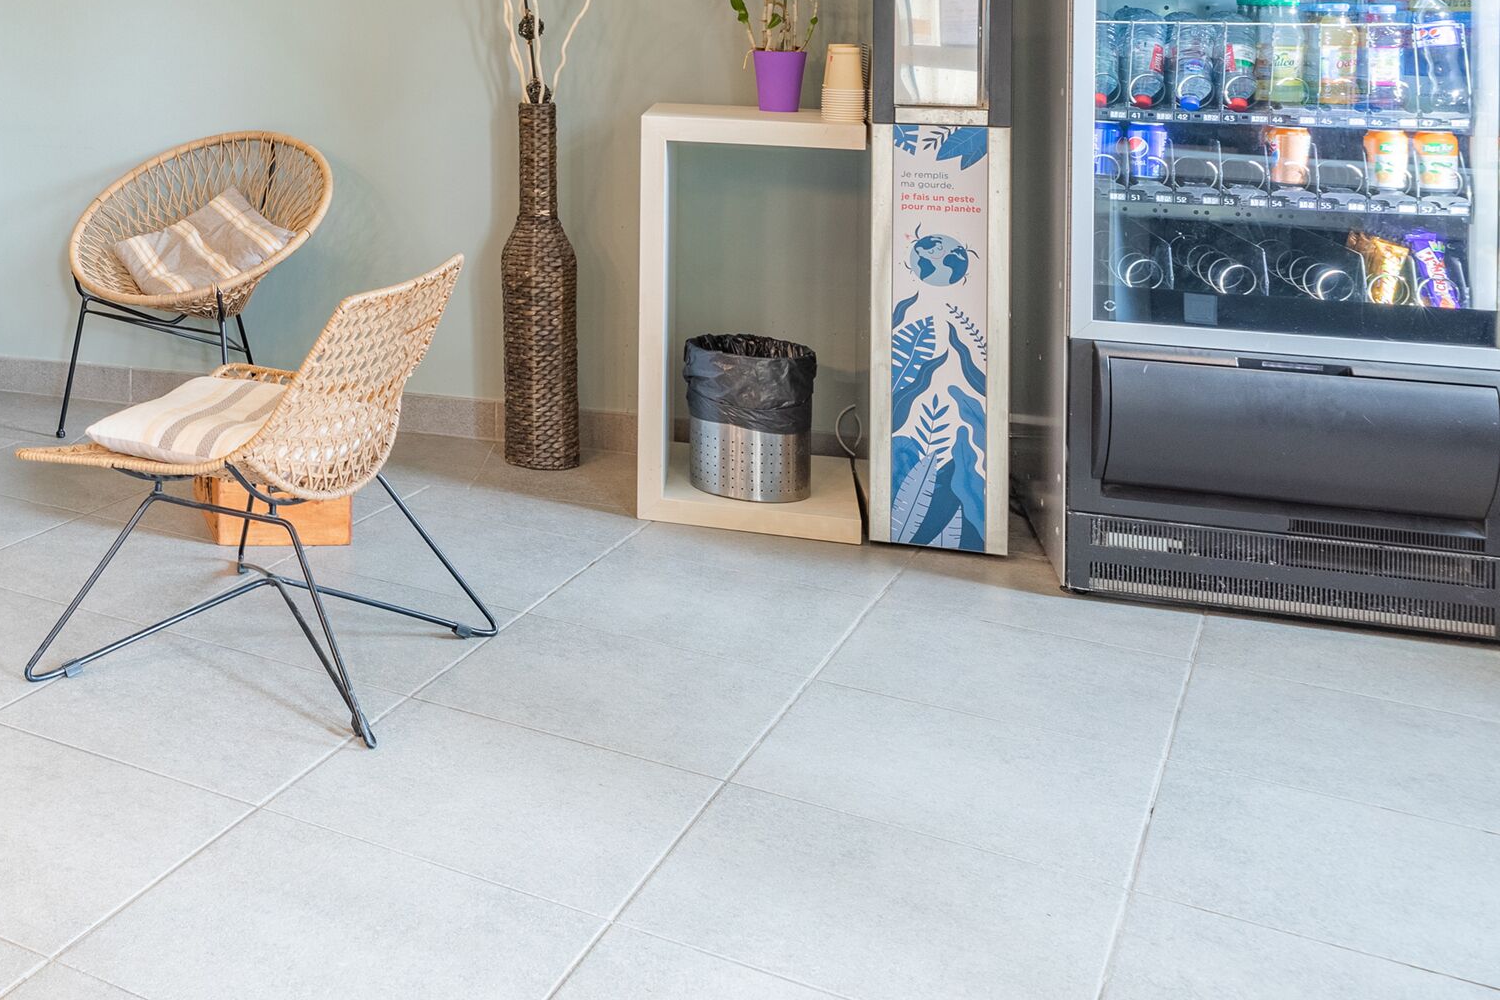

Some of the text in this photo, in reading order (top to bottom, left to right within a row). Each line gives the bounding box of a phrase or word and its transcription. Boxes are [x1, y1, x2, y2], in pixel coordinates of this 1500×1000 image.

[914, 171, 949, 180] remplis
[901, 192, 910, 201] je
[913, 193, 930, 201] fais
[947, 195, 975, 204] geste
[901, 203, 924, 211] pour
[944, 205, 982, 213] planète
[1271, 200, 1283, 208] 54
[1320, 202, 1332, 210] 55
[1370, 204, 1382, 212] 56
